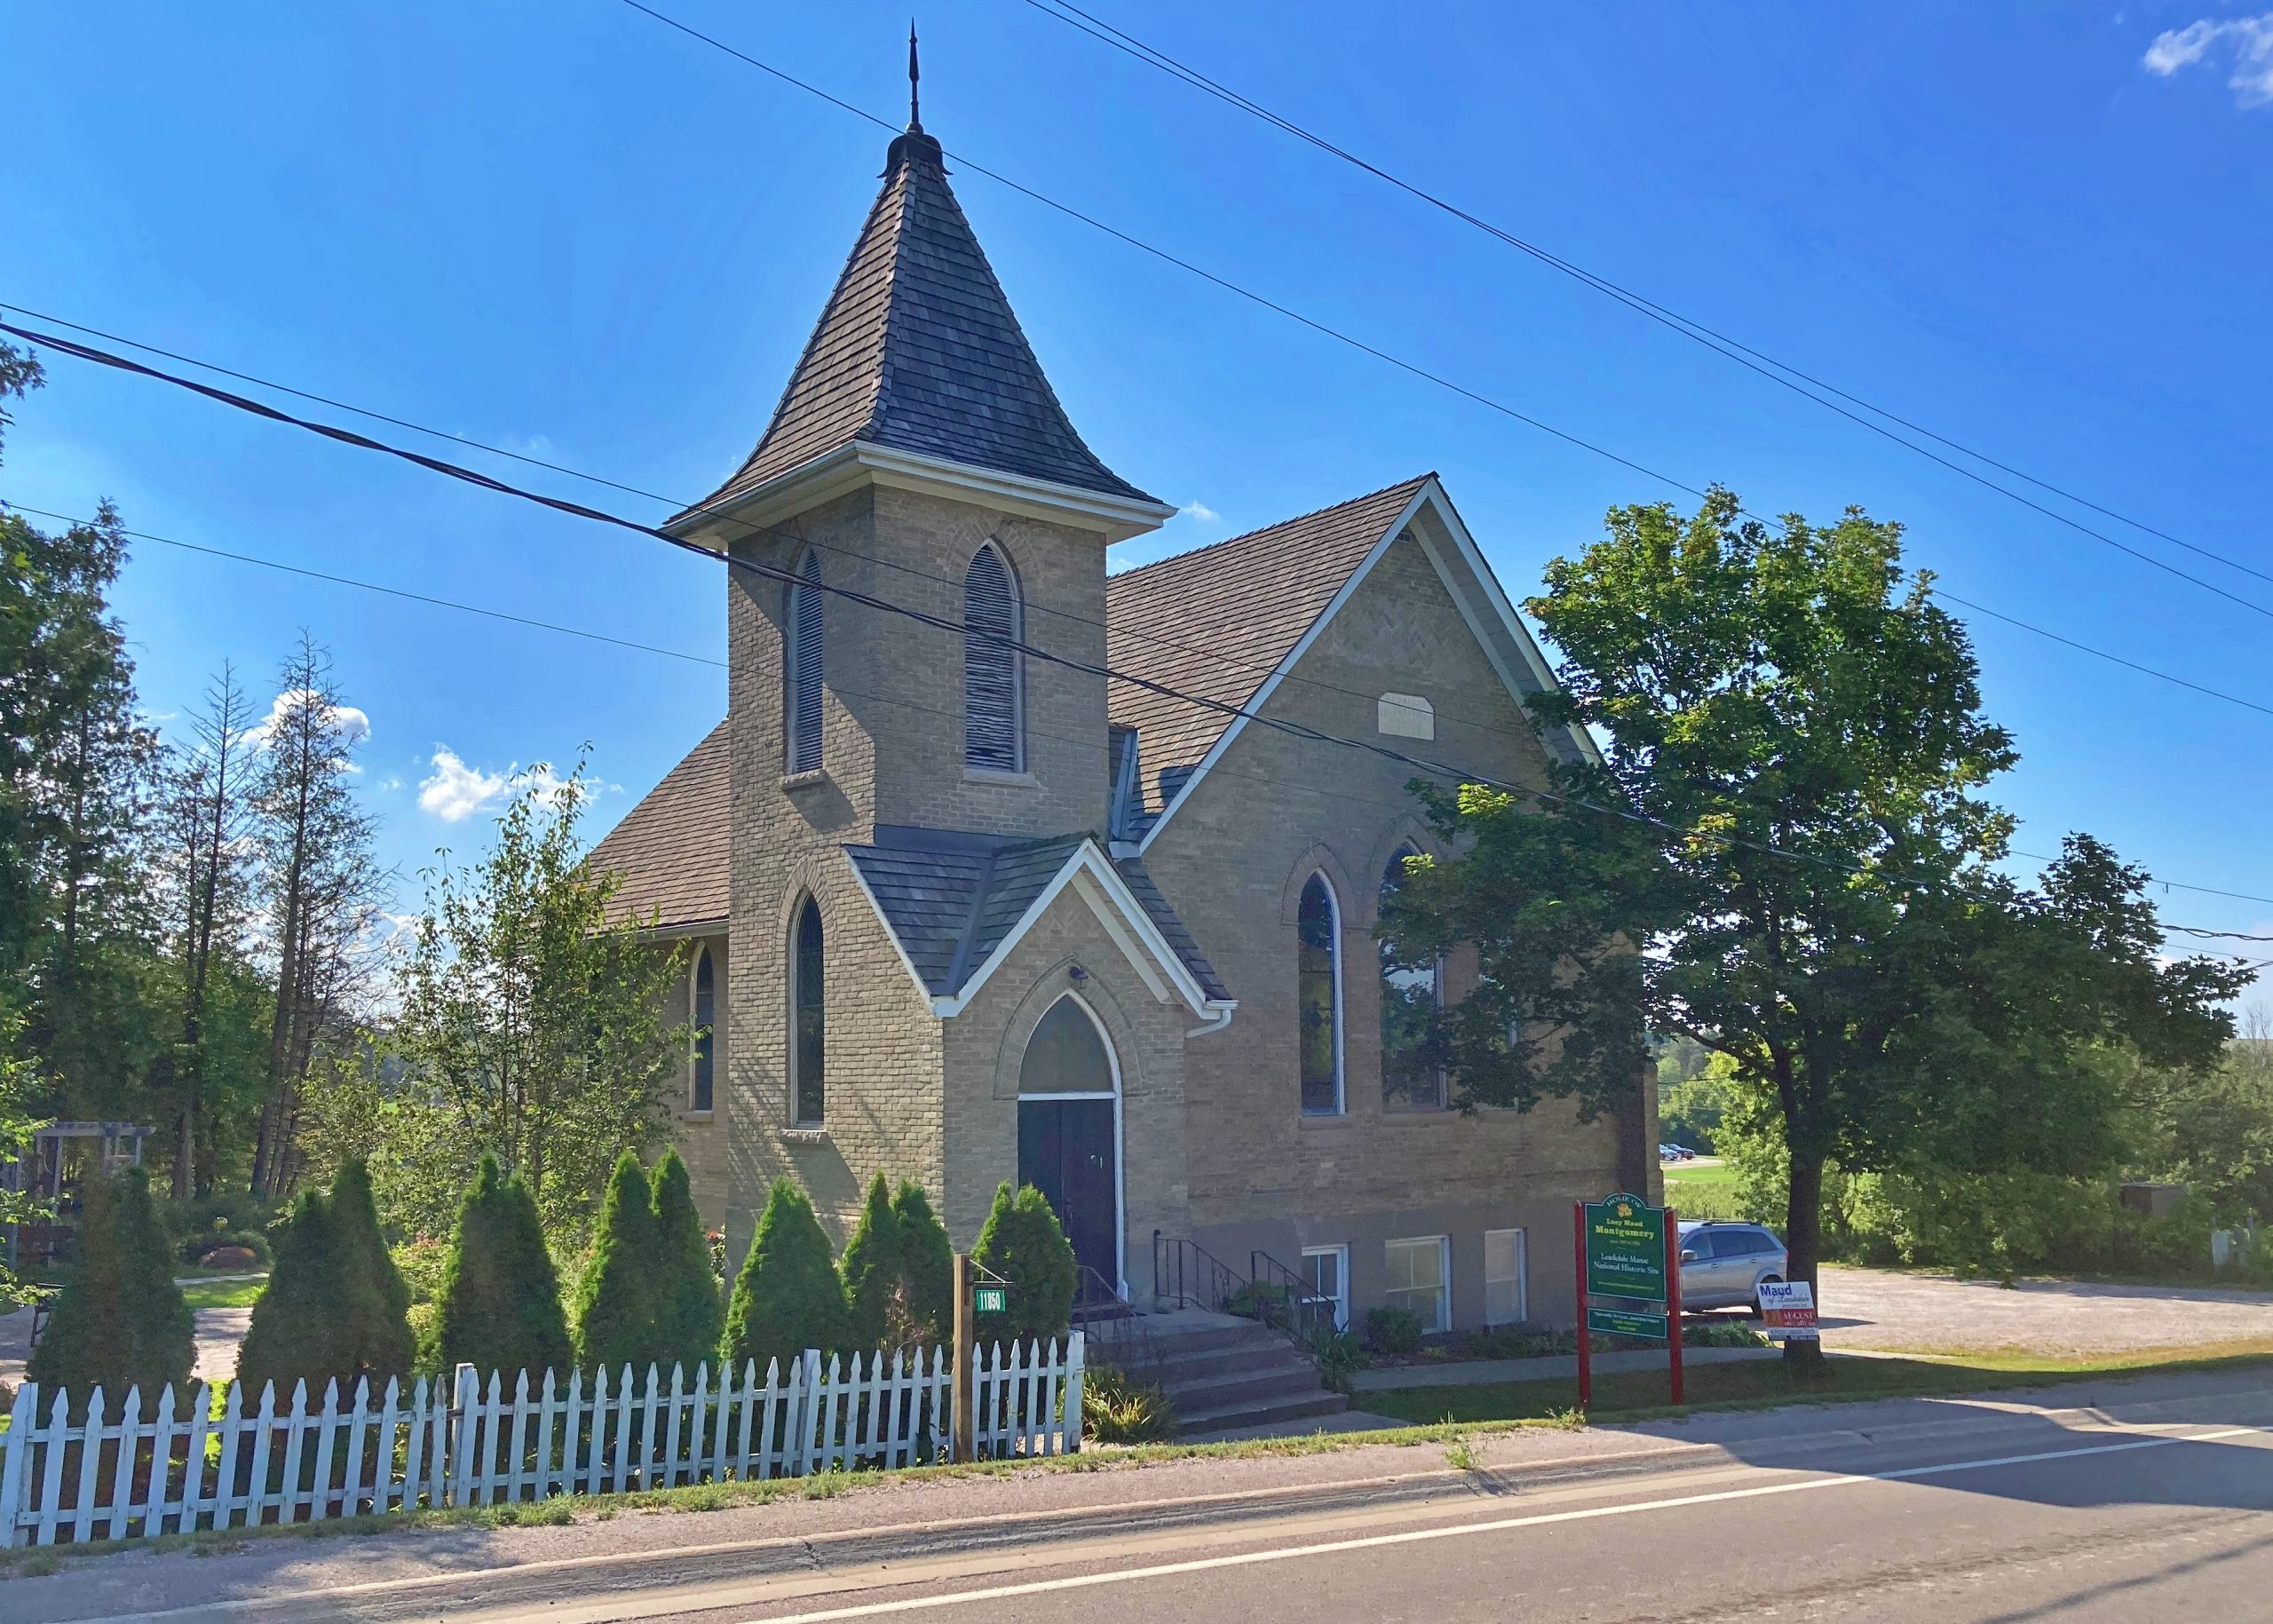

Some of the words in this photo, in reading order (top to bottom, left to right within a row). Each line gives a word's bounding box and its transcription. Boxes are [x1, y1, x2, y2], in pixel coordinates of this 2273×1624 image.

[1596, 1225, 1654, 1240] Montgomery
[1595, 1261, 1620, 1271] National
[1621, 1264, 1646, 1272] Historic
[1760, 1284, 1792, 1296] Maud
[980, 1292, 1001, 1310] 11850
